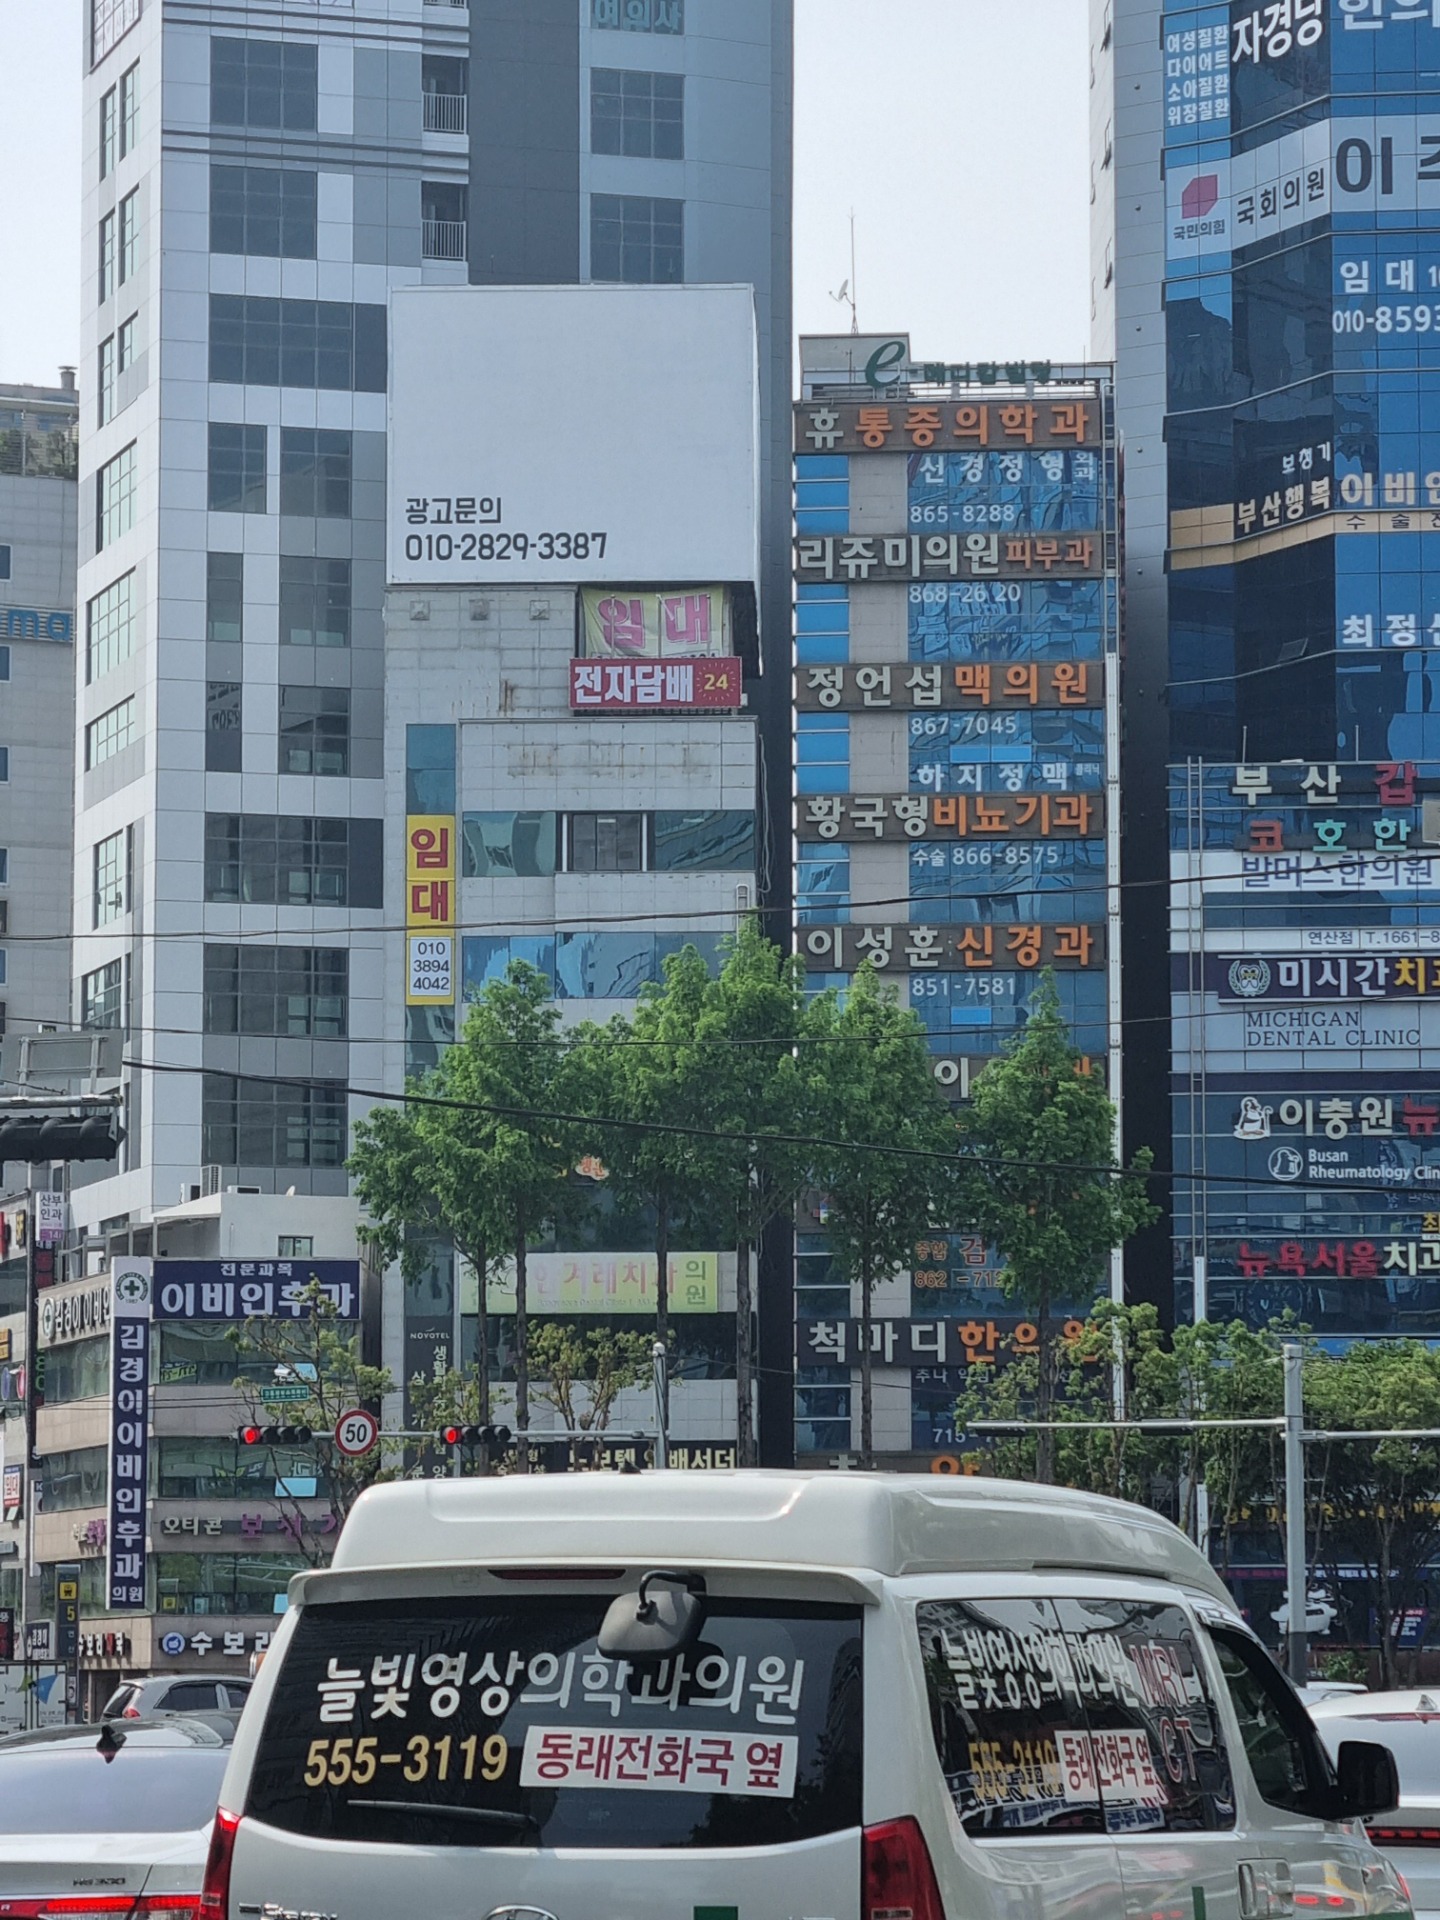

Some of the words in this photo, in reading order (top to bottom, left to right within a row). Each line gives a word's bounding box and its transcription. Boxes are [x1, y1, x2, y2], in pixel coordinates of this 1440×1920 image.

[1166, 25, 1229, 53] 여성질환
[1167, 51, 1229, 78] 다이어트
[1167, 74, 1229, 102] 소아질환
[1167, 98, 1230, 126] 위장질환
[1237, 167, 1325, 225] 국회의원
[1173, 219, 1226, 241] 국민의힘
[1282, 441, 1331, 475] 보청기
[405, 496, 502, 525] 광고문의
[910, 505, 1015, 524] 865-8288
[405, 531, 608, 562] 010-2829-3387
[799, 533, 999, 580] 리쥬미의원
[1005, 537, 1093, 570] 피부과
[597, 594, 713, 650] 임대
[573, 665, 694, 704] 전자담배
[704, 674, 728, 690] 24
[911, 716, 1017, 735] 867-7045
[916, 762, 1068, 792] 하지정맥
[912, 850, 947, 867] 수술
[952, 847, 1059, 865] 866-8575
[411, 828, 449, 921] 임대
[1242, 854, 1433, 889] 발머스한의원
[417, 942, 446, 955] 010
[1308, 931, 1353, 945] 연산점
[413, 959, 450, 973] 3894
[413, 976, 450, 990] 4042
[912, 977, 1016, 996] 851-7581
[1247, 1011, 1360, 1028] MICHIGAN
[1247, 1030, 1336, 1047] DENTAL
[1345, 1029, 1421, 1046] CLINIC
[1308, 1149, 1349, 1163] Busan
[1308, 1165, 1411, 1181] Rheumatology
[220, 1262, 293, 1277] 전문과목
[161, 1280, 355, 1317] 이비인후과
[345, 1423, 367, 1443] 50
[112, 1585, 143, 1603] 의원
[67, 1606, 76, 1621] 5
[317, 1650, 805, 1725] 늘빛영상의학과의원
[303, 1734, 508, 1787] 555-3119
[536, 1732, 734, 1785] 동래전화국
[746, 1741, 784, 1788] 옆
